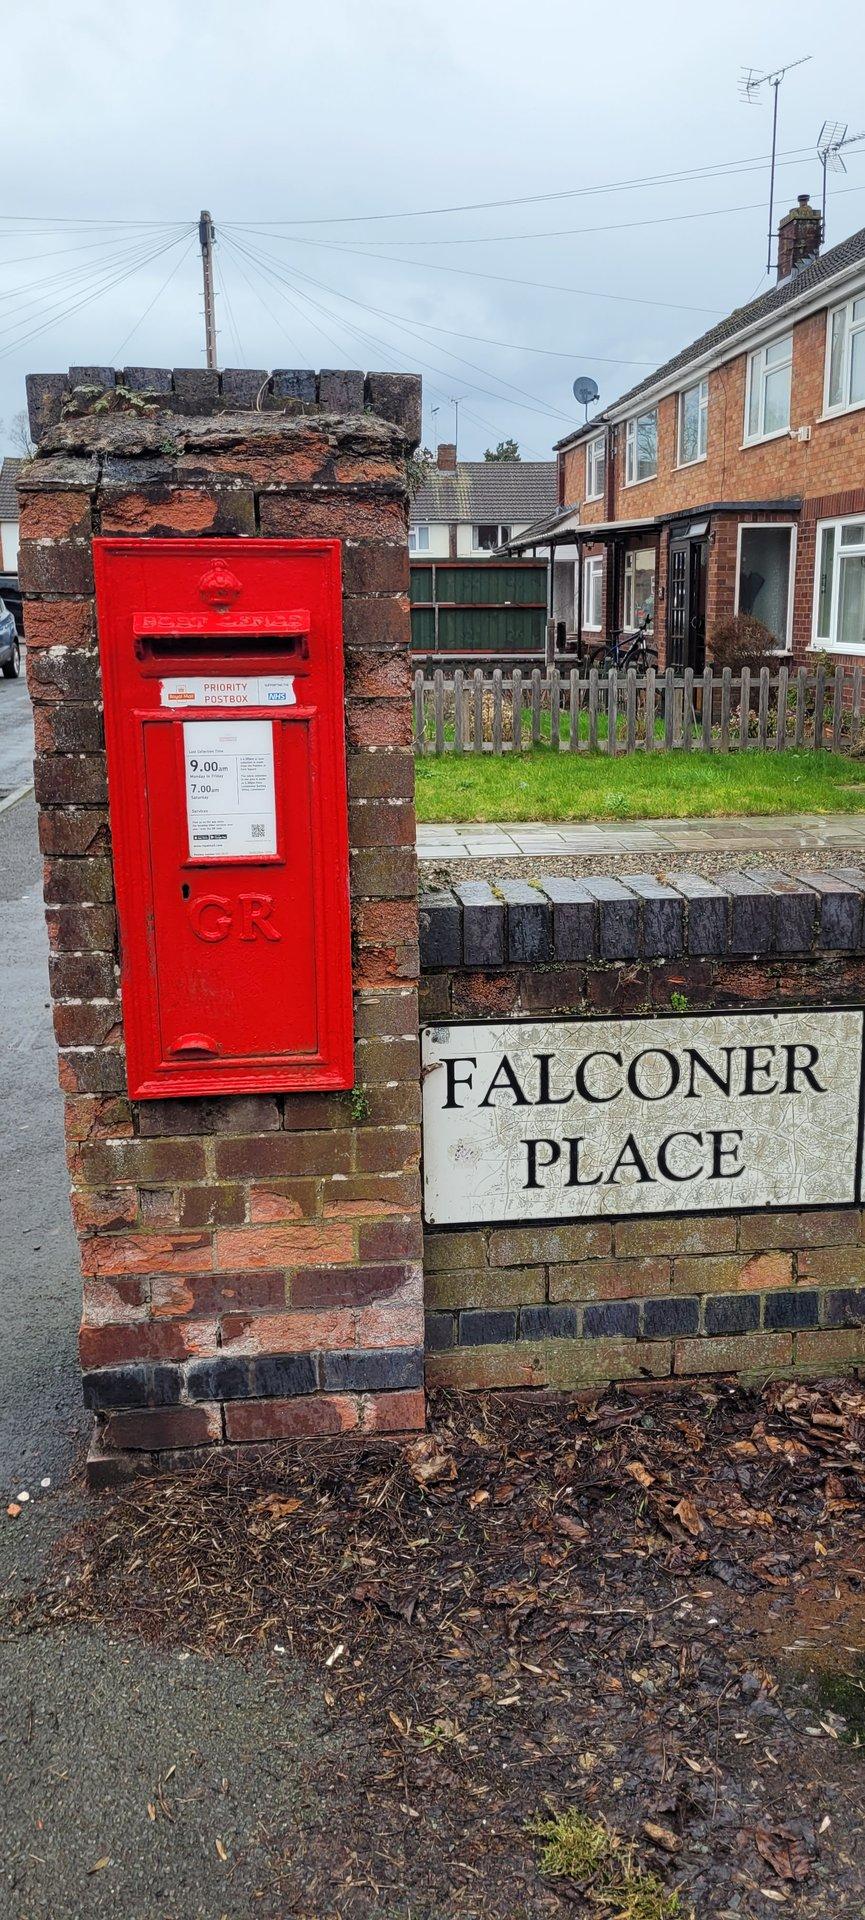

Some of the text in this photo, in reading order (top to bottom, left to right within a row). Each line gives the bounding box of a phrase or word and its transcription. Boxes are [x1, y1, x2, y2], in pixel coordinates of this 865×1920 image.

[203, 683, 248, 692] PRIORITY
[204, 695, 248, 704] POSTBOX
[190, 759, 228, 772] 9.00am
[190, 893, 282, 943] GR
[439, 1044, 828, 1110] FALCONER
[520, 1130, 747, 1190] PLACE
